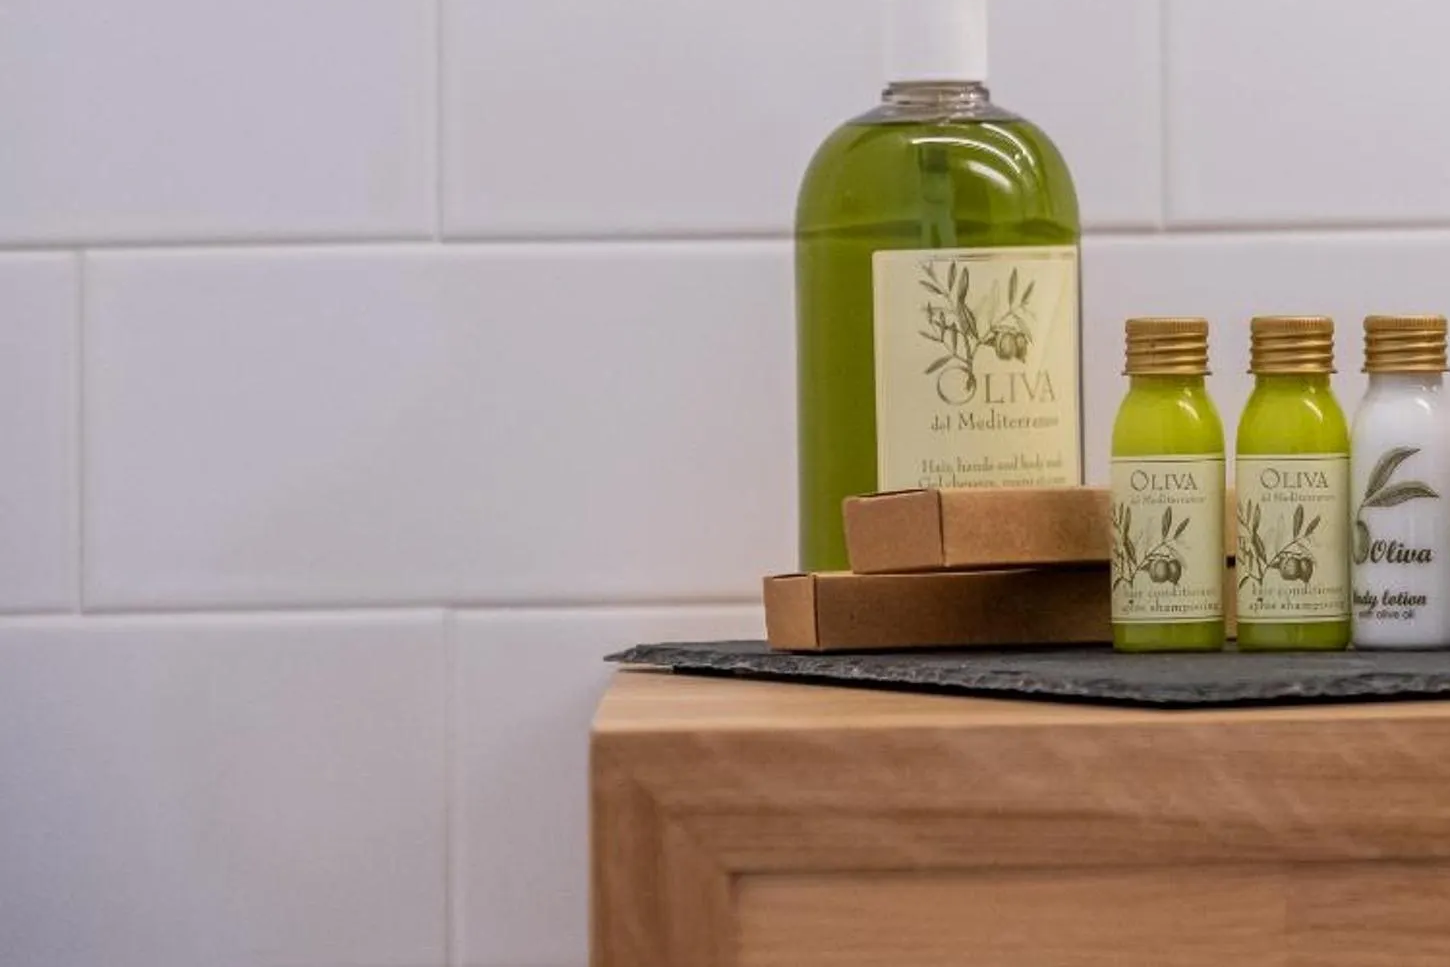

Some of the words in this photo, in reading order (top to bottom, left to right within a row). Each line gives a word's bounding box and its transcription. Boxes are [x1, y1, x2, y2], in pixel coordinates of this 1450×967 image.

[937, 366, 1057, 407] OLIVA
[1130, 469, 1198, 491] OLIVA
[1260, 467, 1329, 489] OLIVA
[1370, 539, 1433, 564] Oliva
[1382, 590, 1427, 607] lotion
